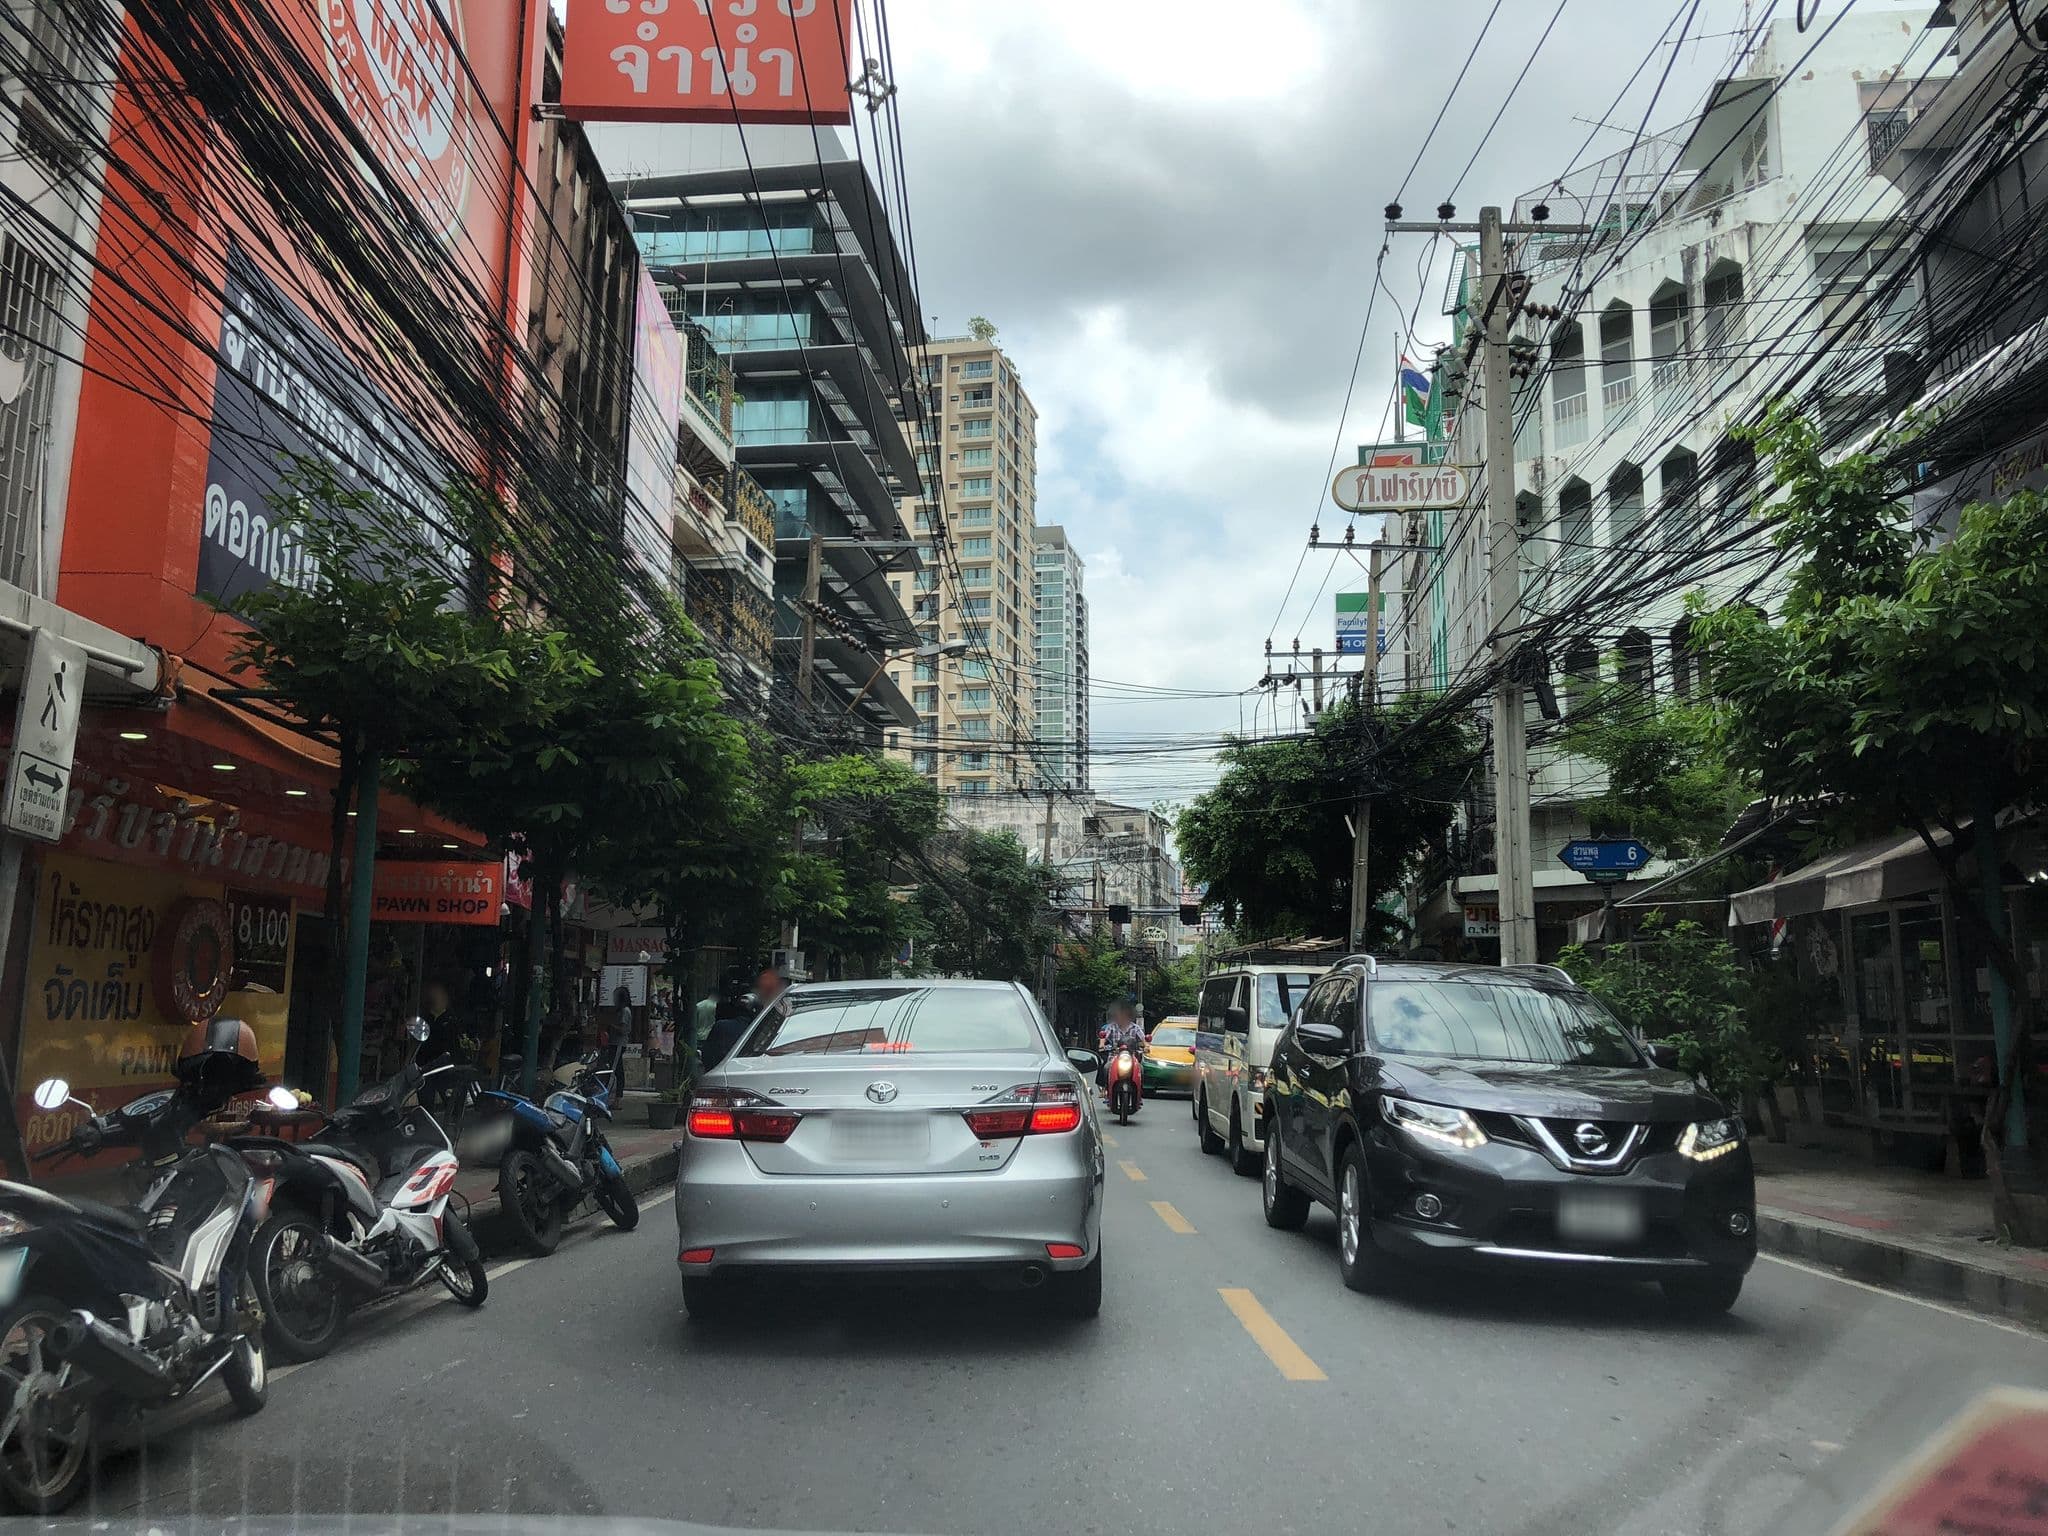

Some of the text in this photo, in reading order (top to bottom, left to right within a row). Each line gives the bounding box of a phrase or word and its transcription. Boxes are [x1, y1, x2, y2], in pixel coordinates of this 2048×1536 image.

[609, 20, 794, 96] จำนำ
[1355, 470, 1457, 503] ก.ฟาร์มาซี
[1627, 846, 1637, 860] 6
[50, 870, 155, 969] ให้ราคาสูง
[376, 896, 489, 914] PAWN SHOP
[228, 902, 288, 948] 18,100
[613, 937, 672, 953] MASSAG
[44, 962, 144, 1020] จัดเต็ม
